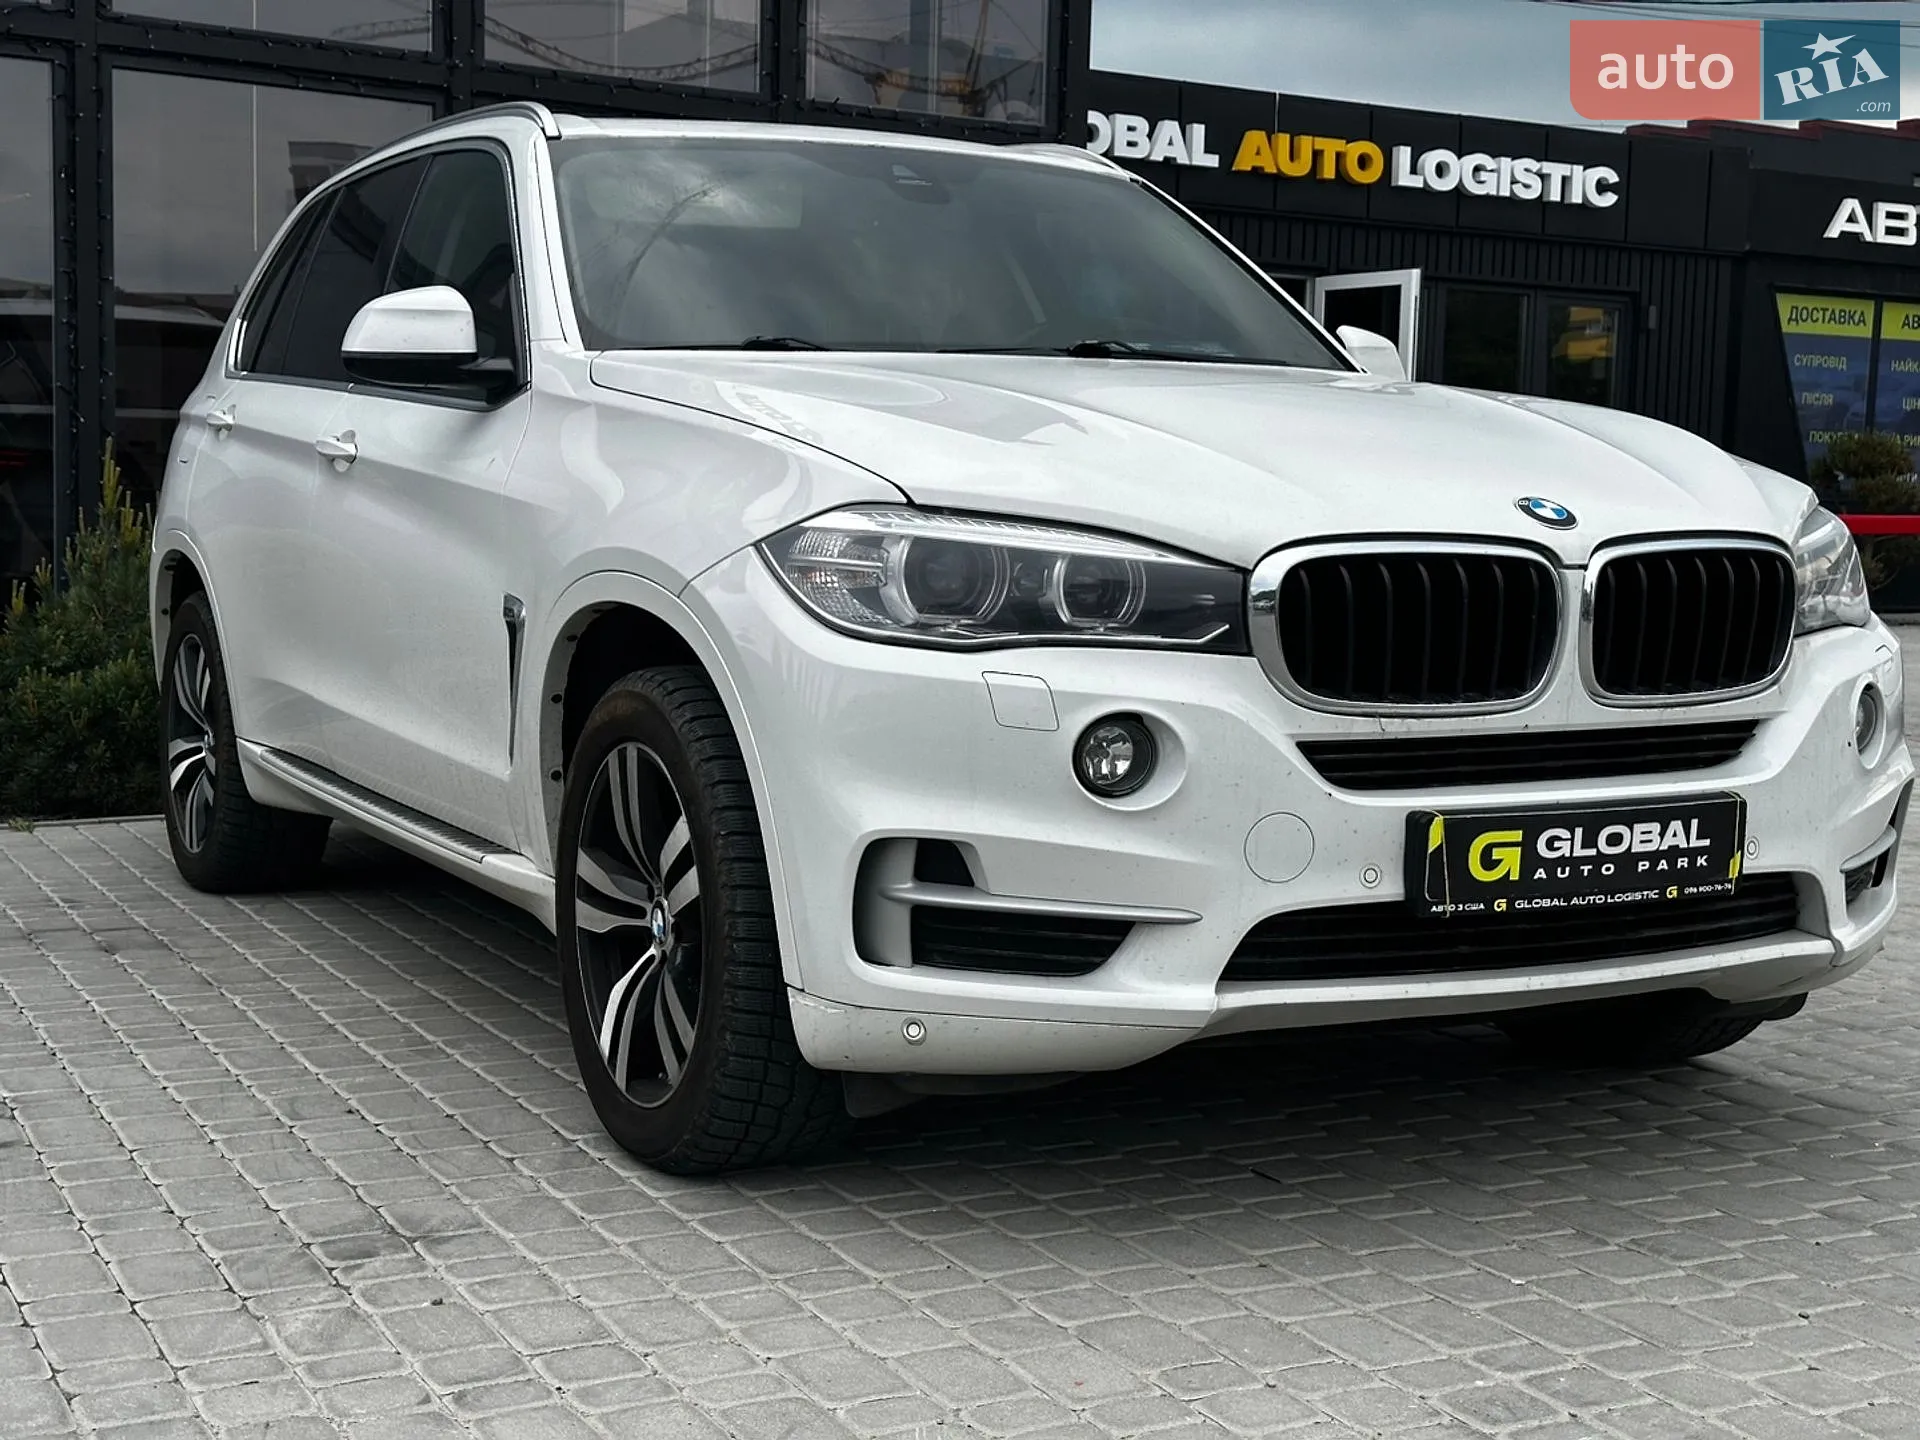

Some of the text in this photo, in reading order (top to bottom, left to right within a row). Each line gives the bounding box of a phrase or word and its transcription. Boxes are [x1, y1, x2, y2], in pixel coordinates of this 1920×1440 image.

[1232, 130, 1384, 186] AUTO
[1392, 145, 1620, 208] LOGISTIC
[1822, 197, 1920, 247] АВ
[1787, 305, 1867, 328] ДОСТАВКА
[1794, 353, 1848, 371] СУПРОВІД
[1890, 357, 1920, 373] НАЙК
[1801, 391, 1834, 406] ПІСЛЯ
[1536, 818, 1711, 859] GLOBAL
[1533, 854, 1709, 881] AUTO PARK
[1515, 897, 1567, 909] GLOBAL
[1570, 894, 1605, 906] AUTO
[1607, 889, 1659, 903] LOGISTIC
